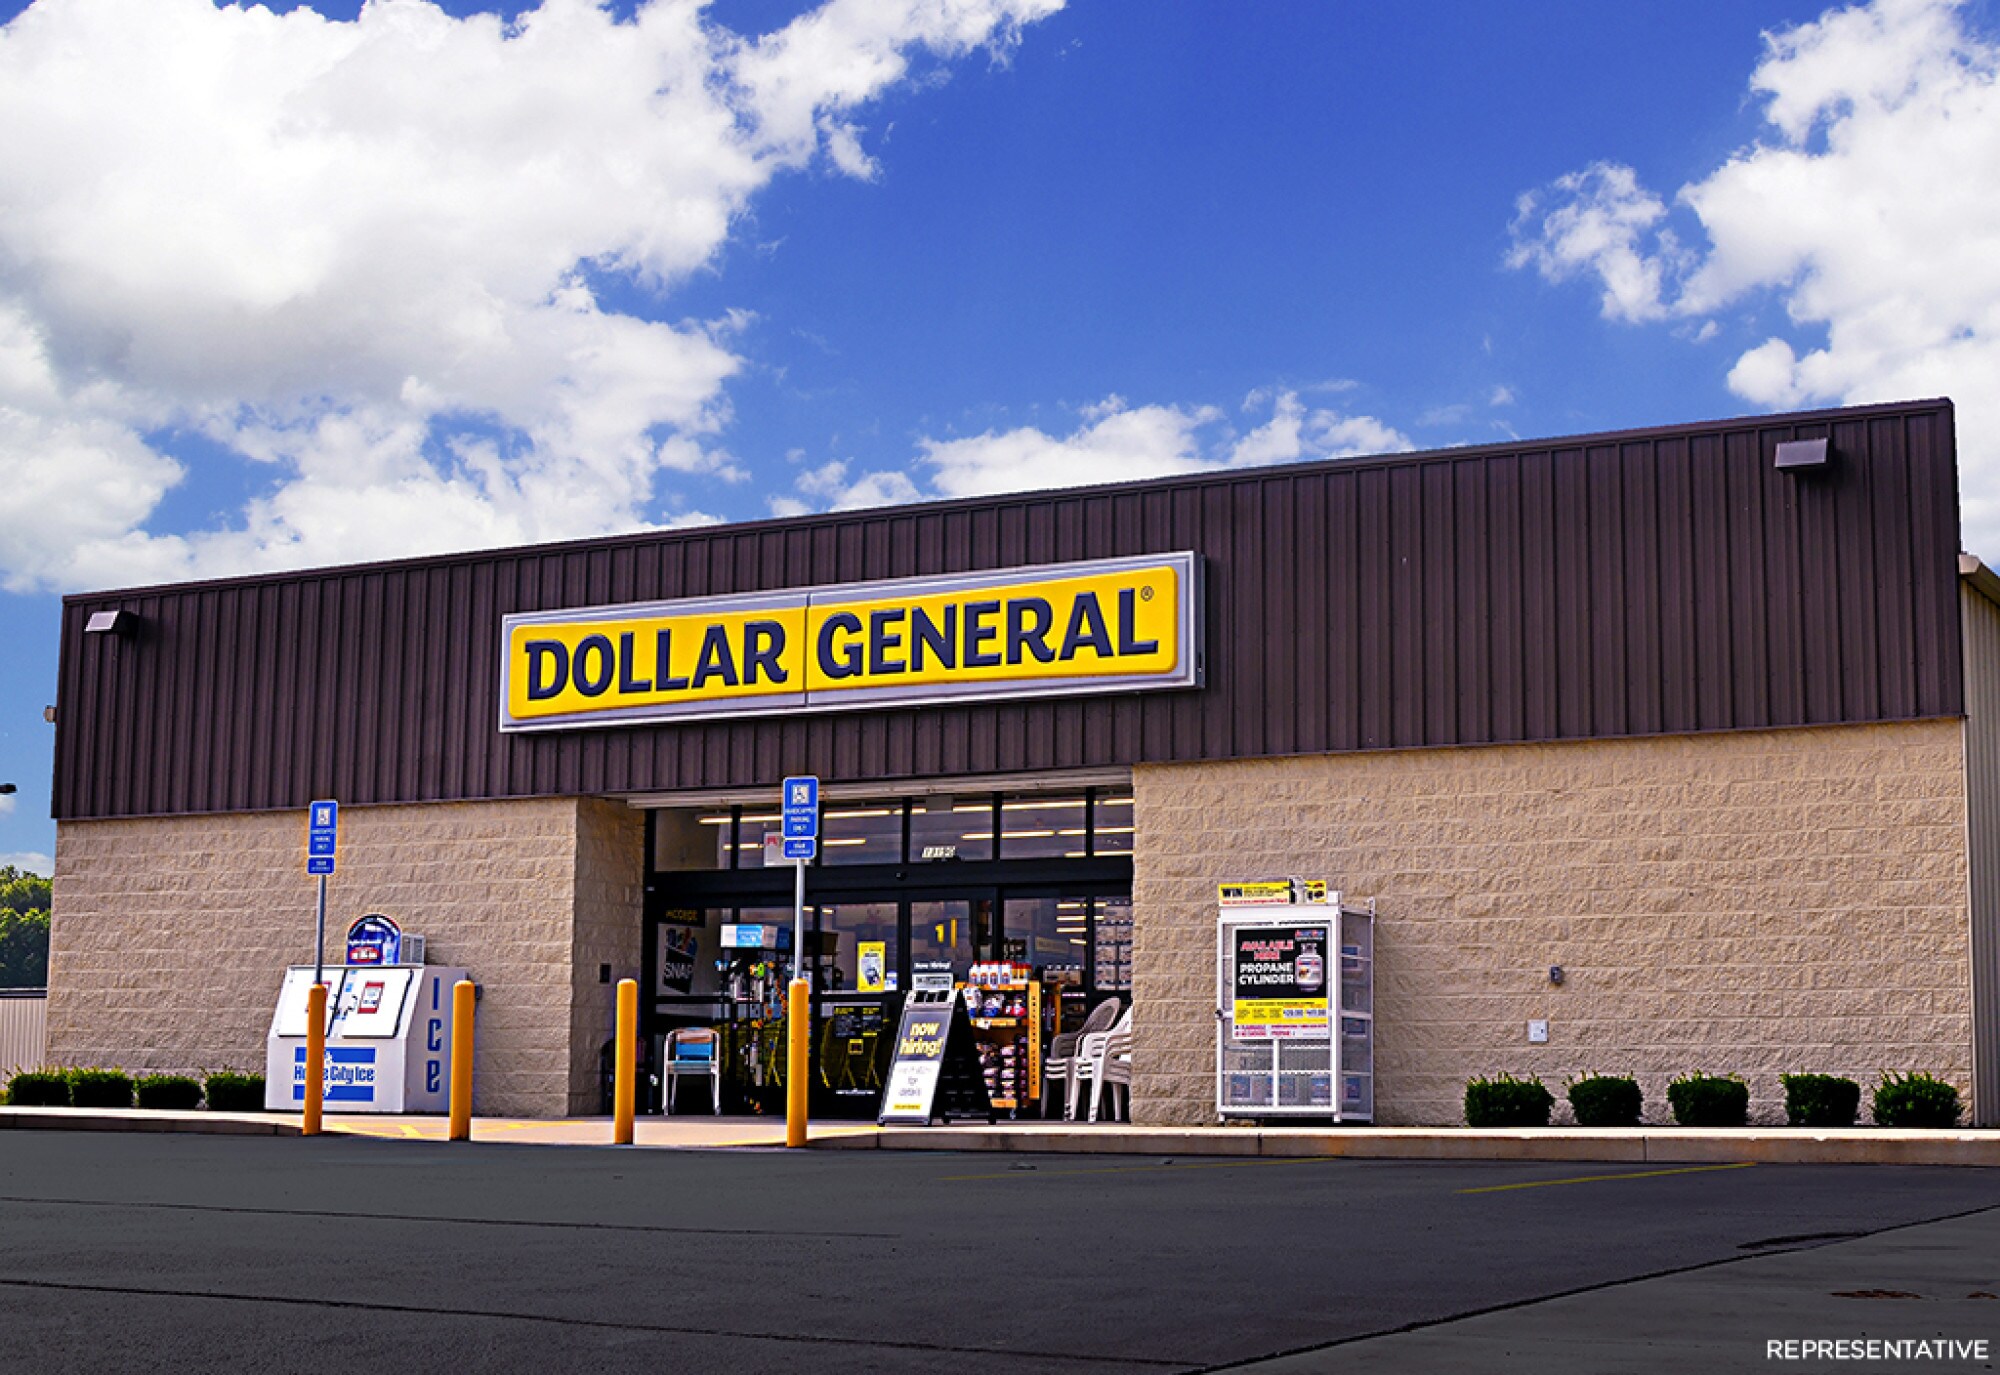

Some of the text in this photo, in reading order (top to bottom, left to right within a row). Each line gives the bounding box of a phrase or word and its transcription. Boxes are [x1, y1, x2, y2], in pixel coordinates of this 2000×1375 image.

[524, 587, 1159, 701] DOLLAR GENERAL
[1240, 962, 1293, 973] PROPANE
[1239, 974, 1293, 985] CYLINDER
[909, 1022, 940, 1036] now
[899, 1036, 945, 1057] hiring!
[330, 1066, 354, 1084] City
[355, 1066, 376, 1082] Ice
